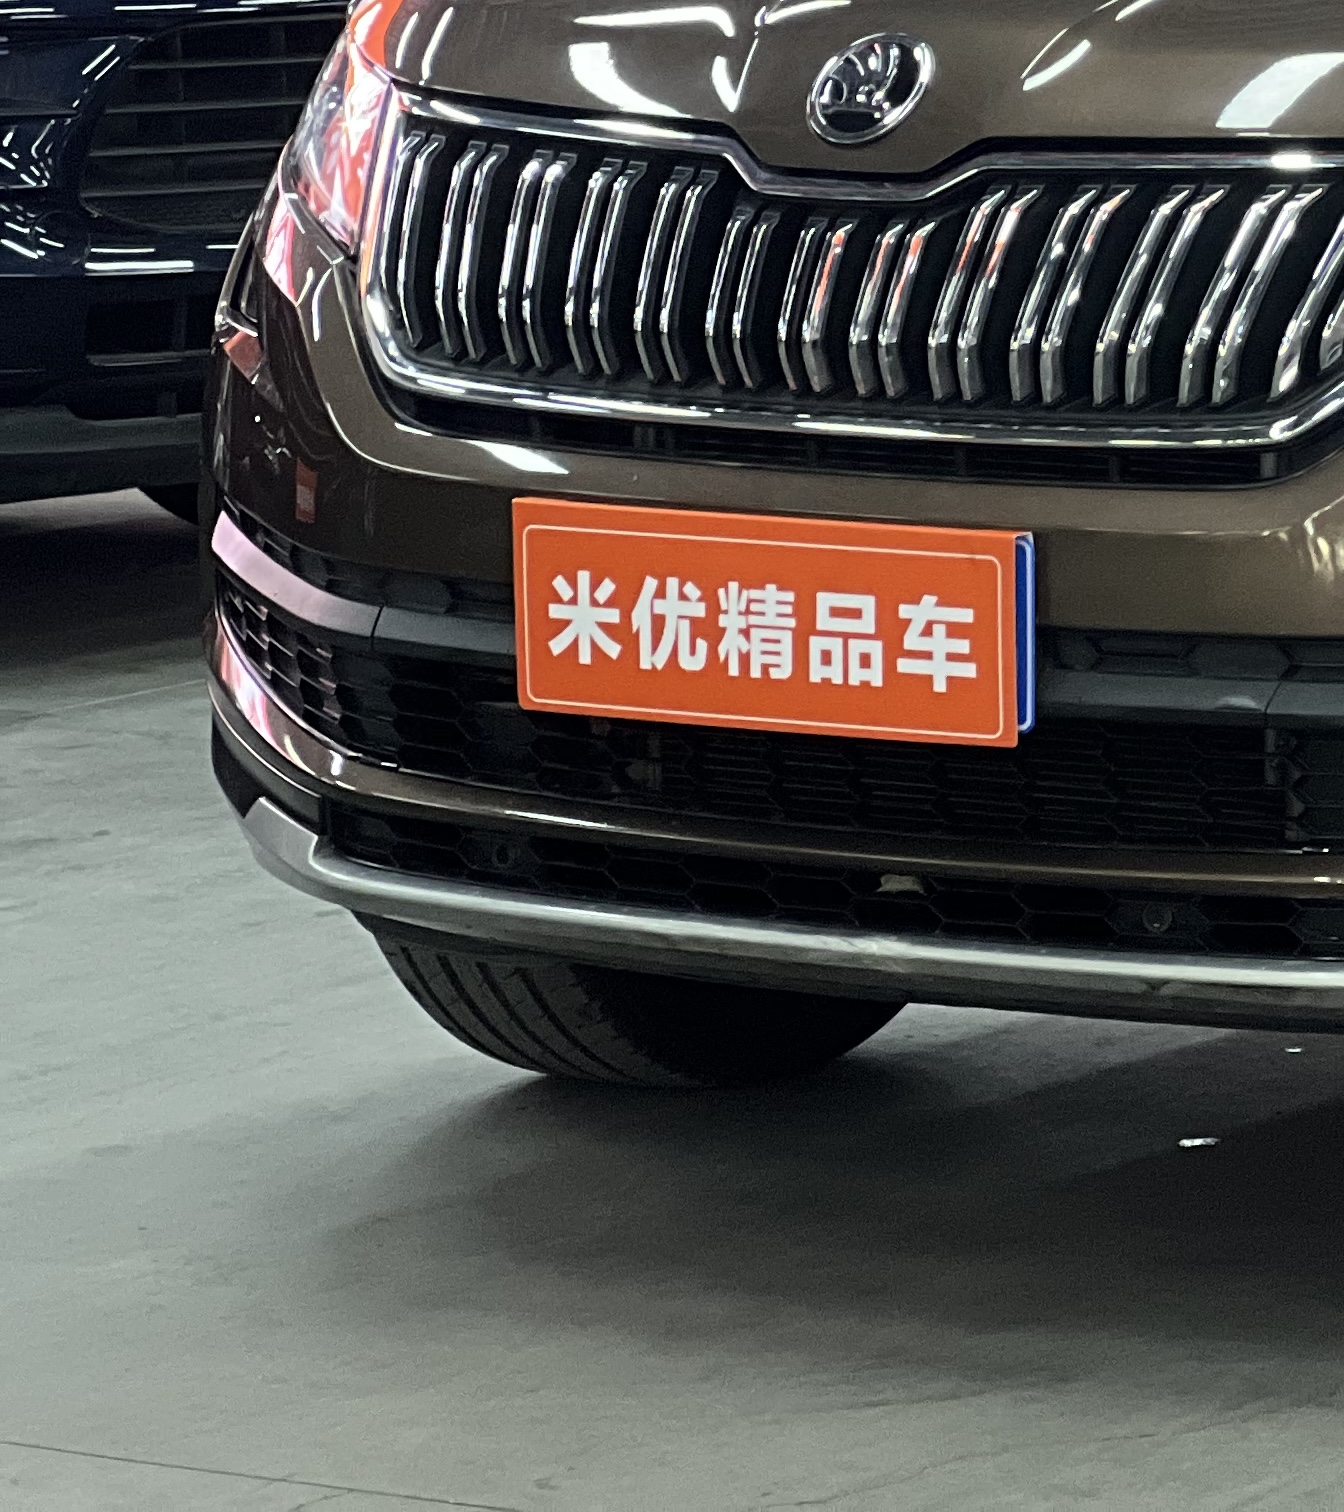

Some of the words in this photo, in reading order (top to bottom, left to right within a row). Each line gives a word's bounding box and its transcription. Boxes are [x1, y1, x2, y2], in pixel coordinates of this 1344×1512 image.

[547, 569, 978, 693] 米优精品车
